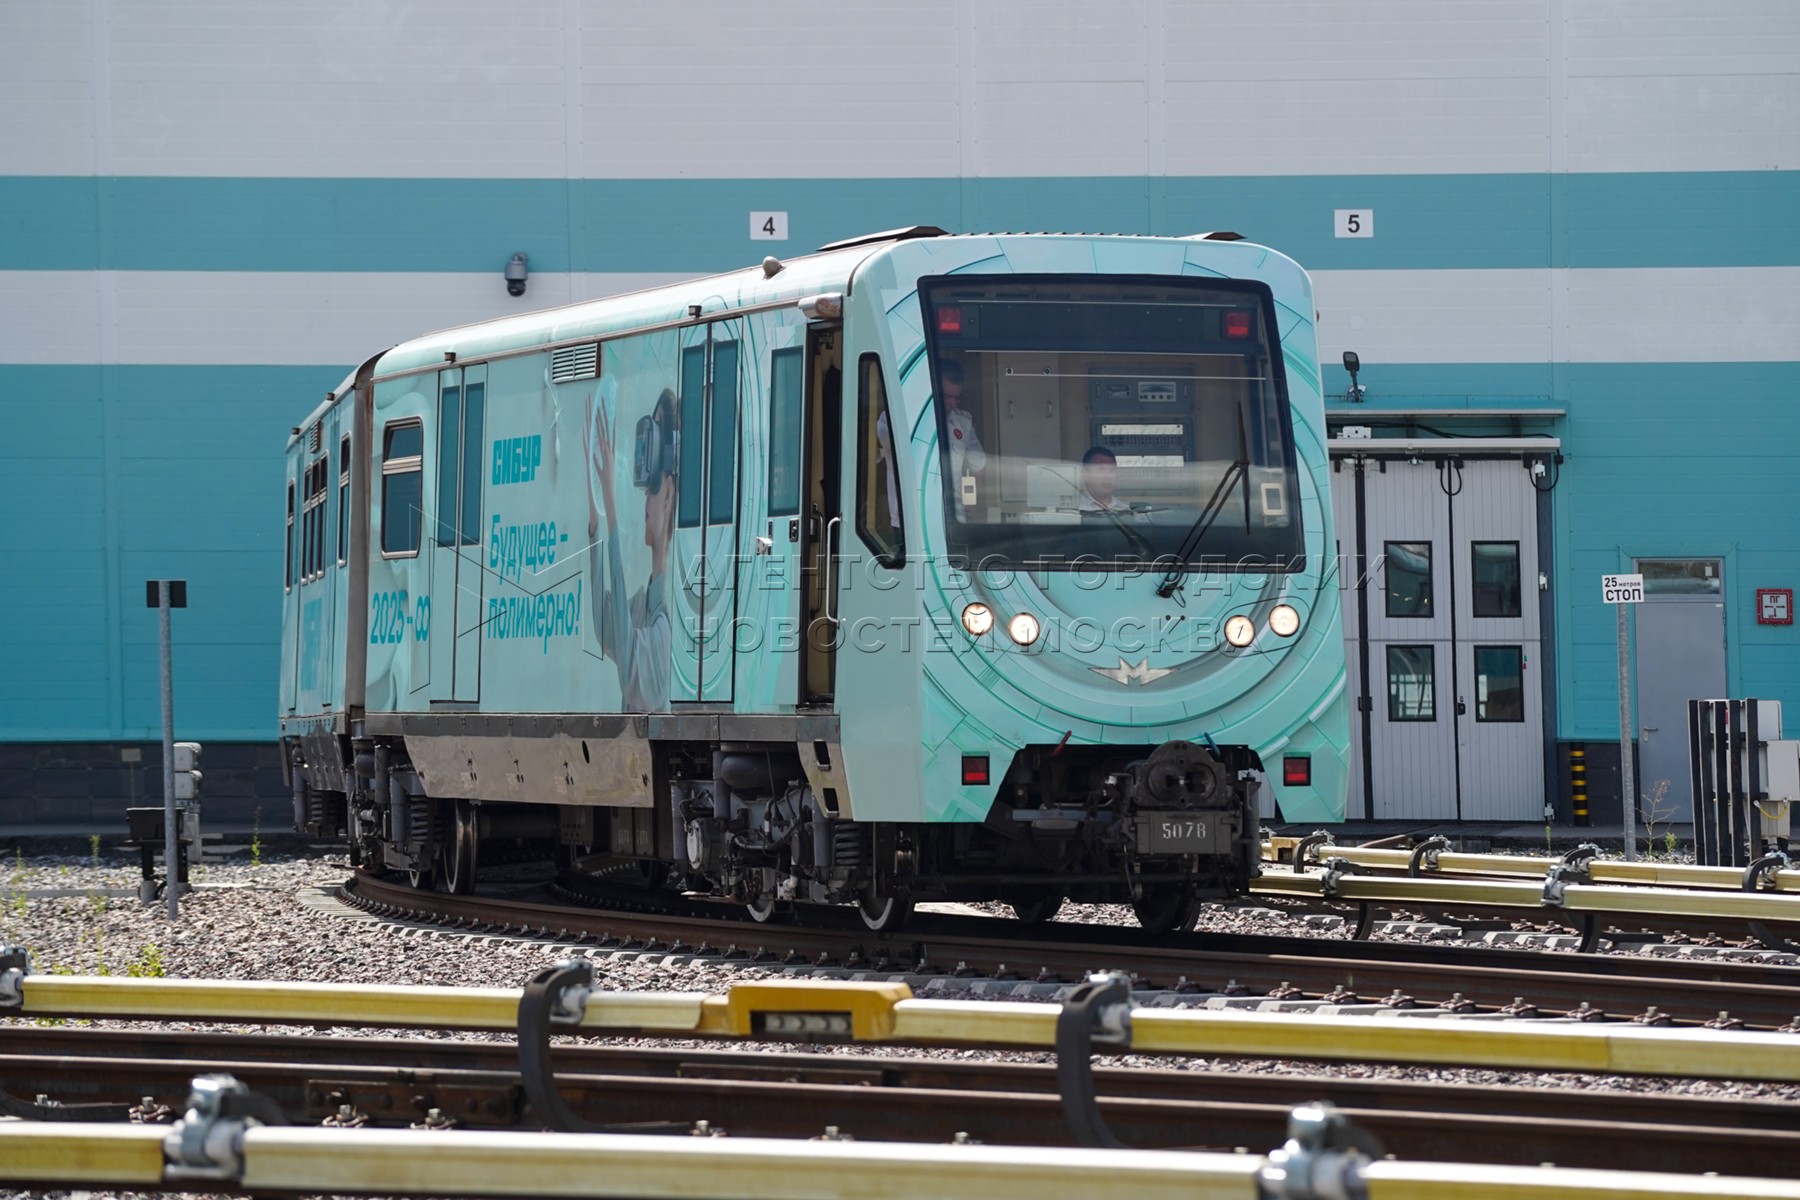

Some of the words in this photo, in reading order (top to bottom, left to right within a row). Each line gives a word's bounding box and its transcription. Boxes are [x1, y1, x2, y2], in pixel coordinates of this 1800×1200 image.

[762, 216, 776, 236] 4
[1348, 214, 1360, 233] 5
[492, 434, 542, 486] СИБУР
[1604, 577, 1618, 588] 25
[1606, 589, 1641, 601] СТОП
[1770, 595, 1780, 604] ПГ
[488, 579, 582, 655] полимерно!
[1162, 821, 1206, 839] 5078
